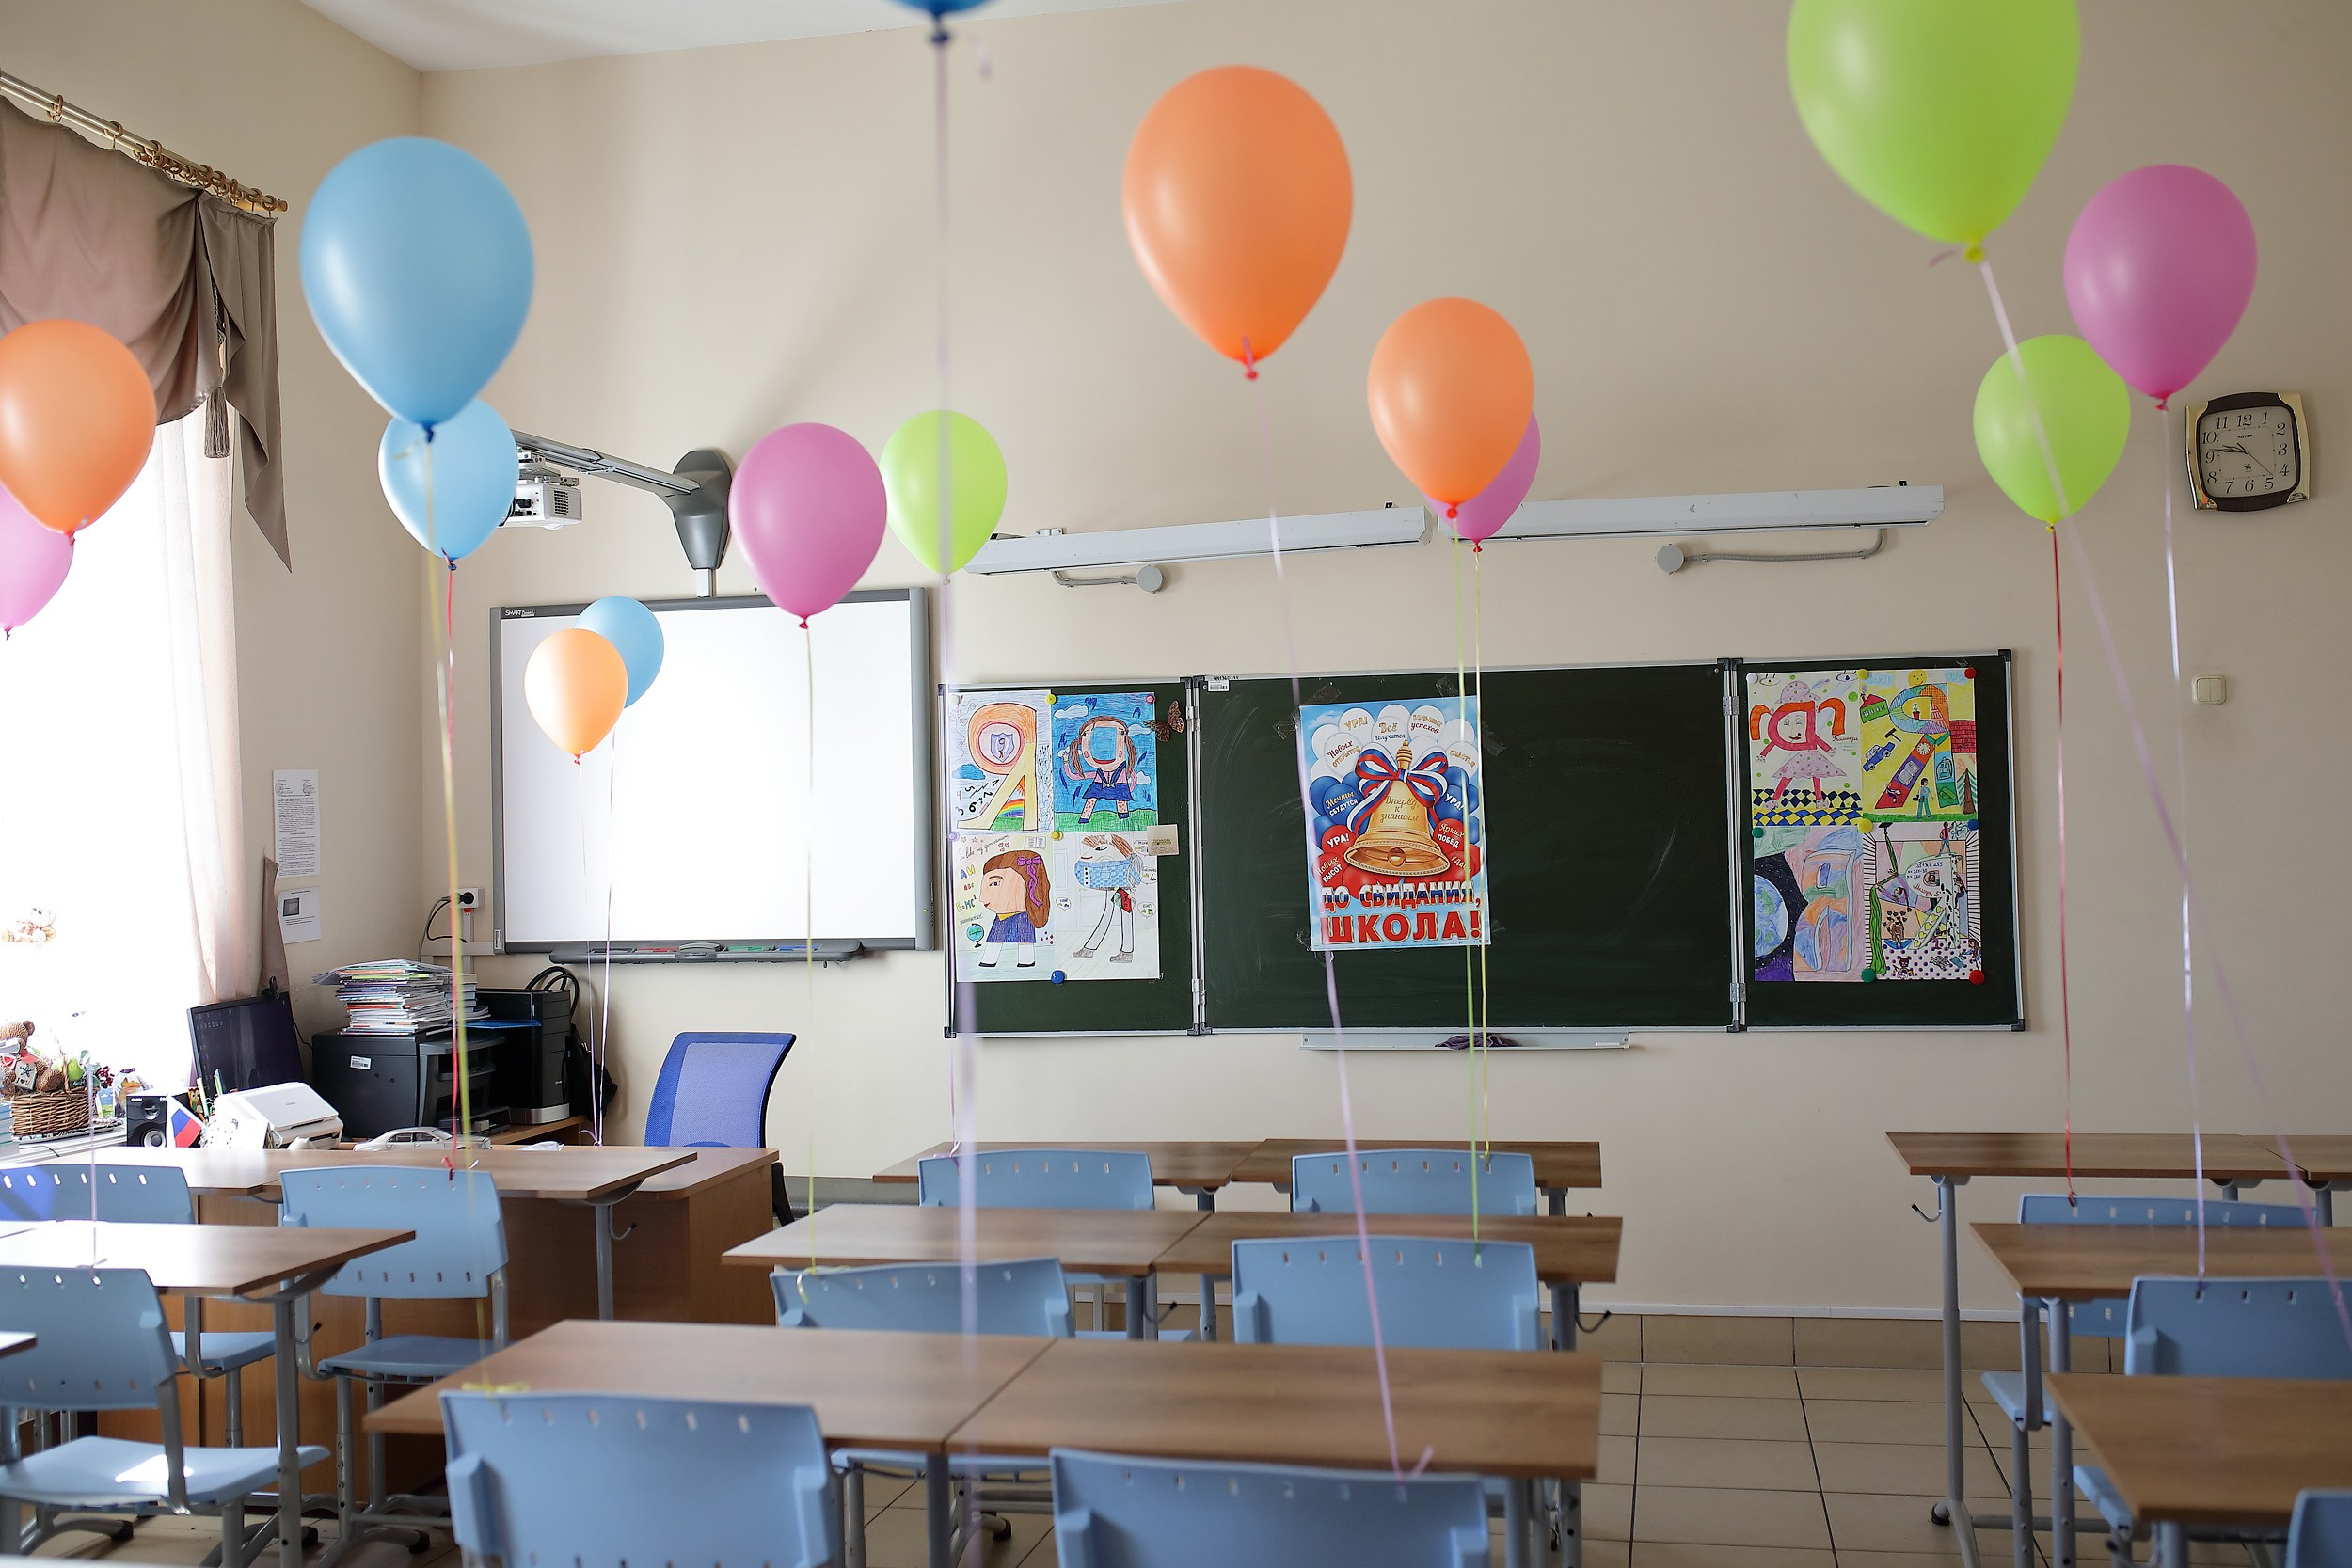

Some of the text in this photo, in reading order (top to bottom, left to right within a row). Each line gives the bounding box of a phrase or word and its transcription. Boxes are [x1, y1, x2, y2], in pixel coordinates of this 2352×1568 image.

[2216, 416, 2228, 430] 11
[2235, 414, 2252, 428] 12
[2262, 411, 2268, 425] 1
[2277, 422, 2286, 436] 2
[2201, 431, 2217, 445] 10
[2278, 443, 2288, 456] 3
[2205, 451, 2215, 464] 9
[2279, 463, 2290, 477] 4
[2206, 471, 2217, 484] 8
[2264, 477, 2274, 490] 5
[2225, 481, 2233, 494] 7
[2244, 479, 2255, 492] 6
[1343, 716, 1369, 732] УРА!
[1378, 721, 1398, 734] Всё
[1410, 721, 1440, 735] успехов
[1374, 734, 1406, 743] получится
[1327, 740, 1353, 759] Новых
[969, 801, 977, 813] 6
[1325, 791, 1355, 810] Мечты
[1328, 799, 1359, 816] СБУДУТСЯ
[1444, 793, 1465, 811] УРА!
[1380, 812, 1420, 824] знаниям
[1438, 823, 1465, 838] Ярких
[1327, 833, 1350, 848] УРА!
[1437, 833, 1460, 849] ПОБЕД
[1322, 863, 1343, 883] ВЫСОТ
[1320, 879, 1482, 914] ДО СВИДАНИЯ,
[1320, 910, 1484, 945] ШКОЛА!
